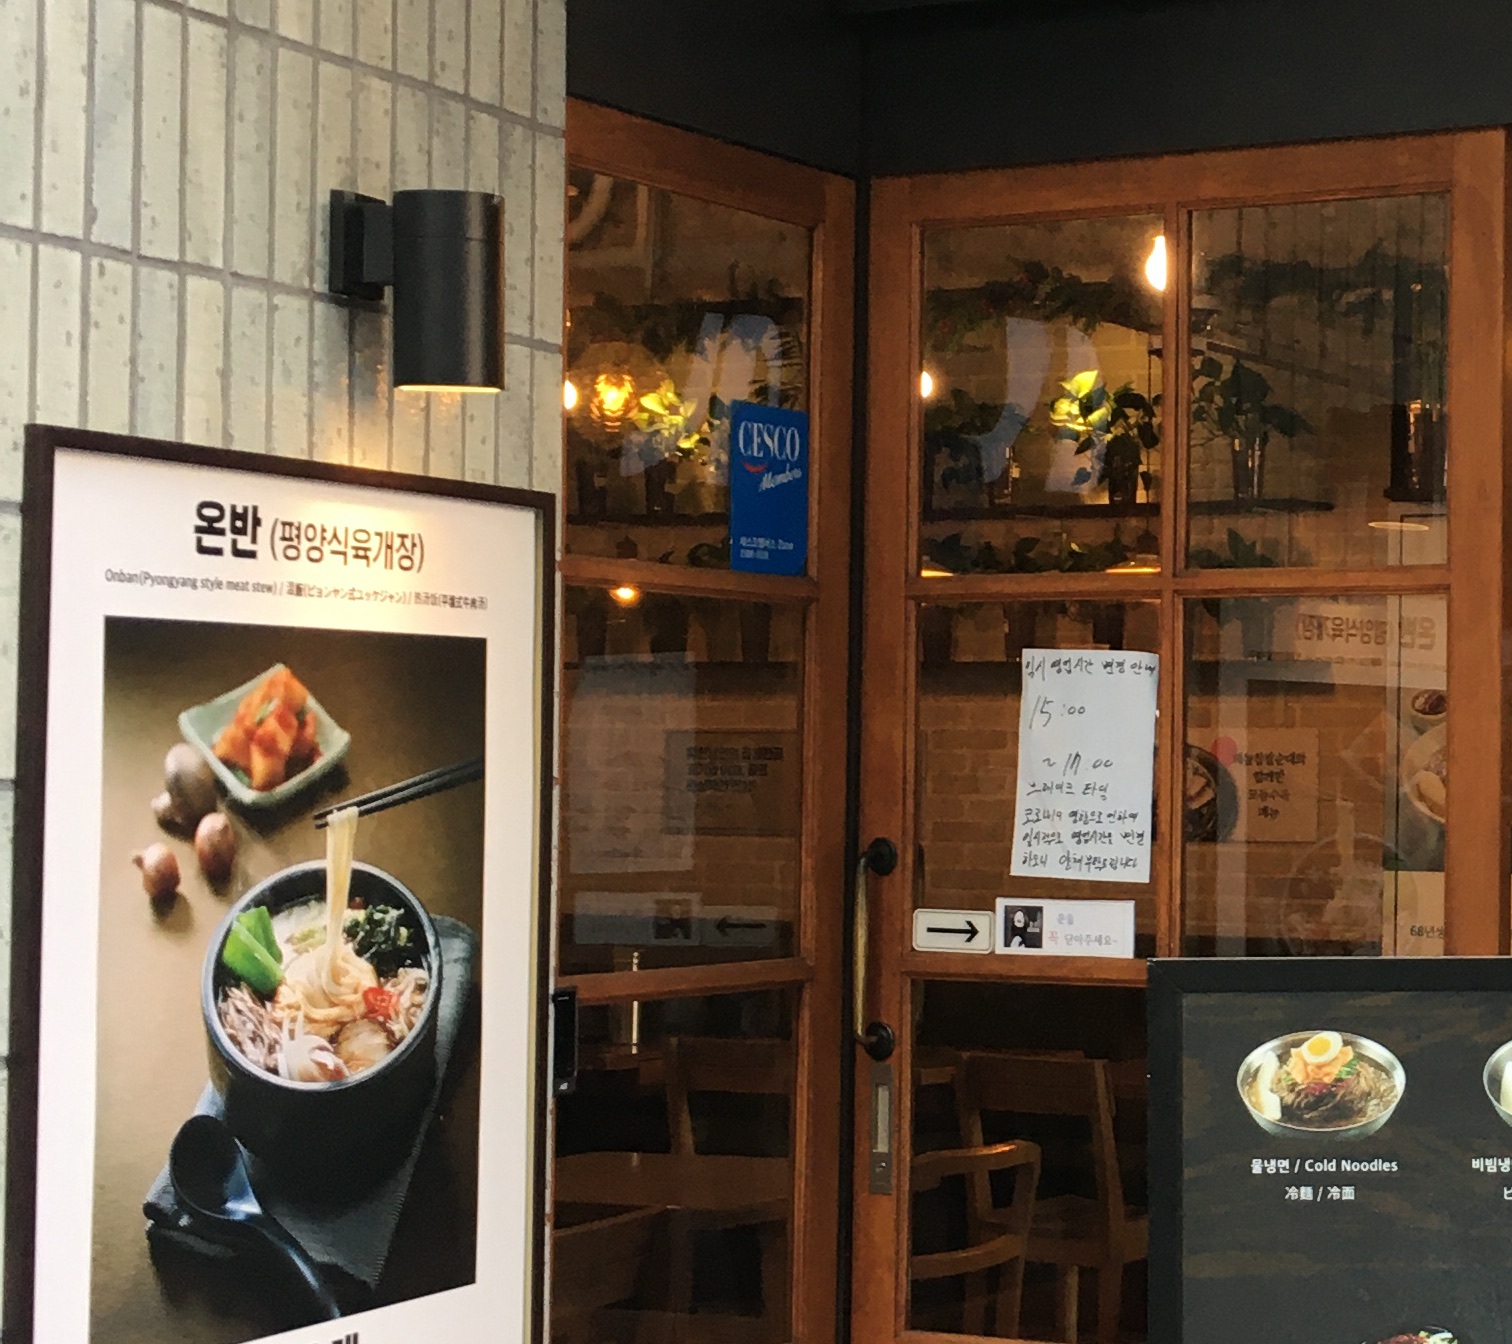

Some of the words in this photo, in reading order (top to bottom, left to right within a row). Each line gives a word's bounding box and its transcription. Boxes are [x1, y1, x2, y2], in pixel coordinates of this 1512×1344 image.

[738, 420, 800, 462] CESCO
[193, 500, 262, 559] 온반
[270, 517, 425, 573] (평양식육개장)
[1250, 1158, 1290, 1174] 물냉면
[1304, 1158, 1336, 1172] Cold
[1341, 1158, 1398, 1172] Noodles
[1326, 1185, 1355, 1201] 冷面
